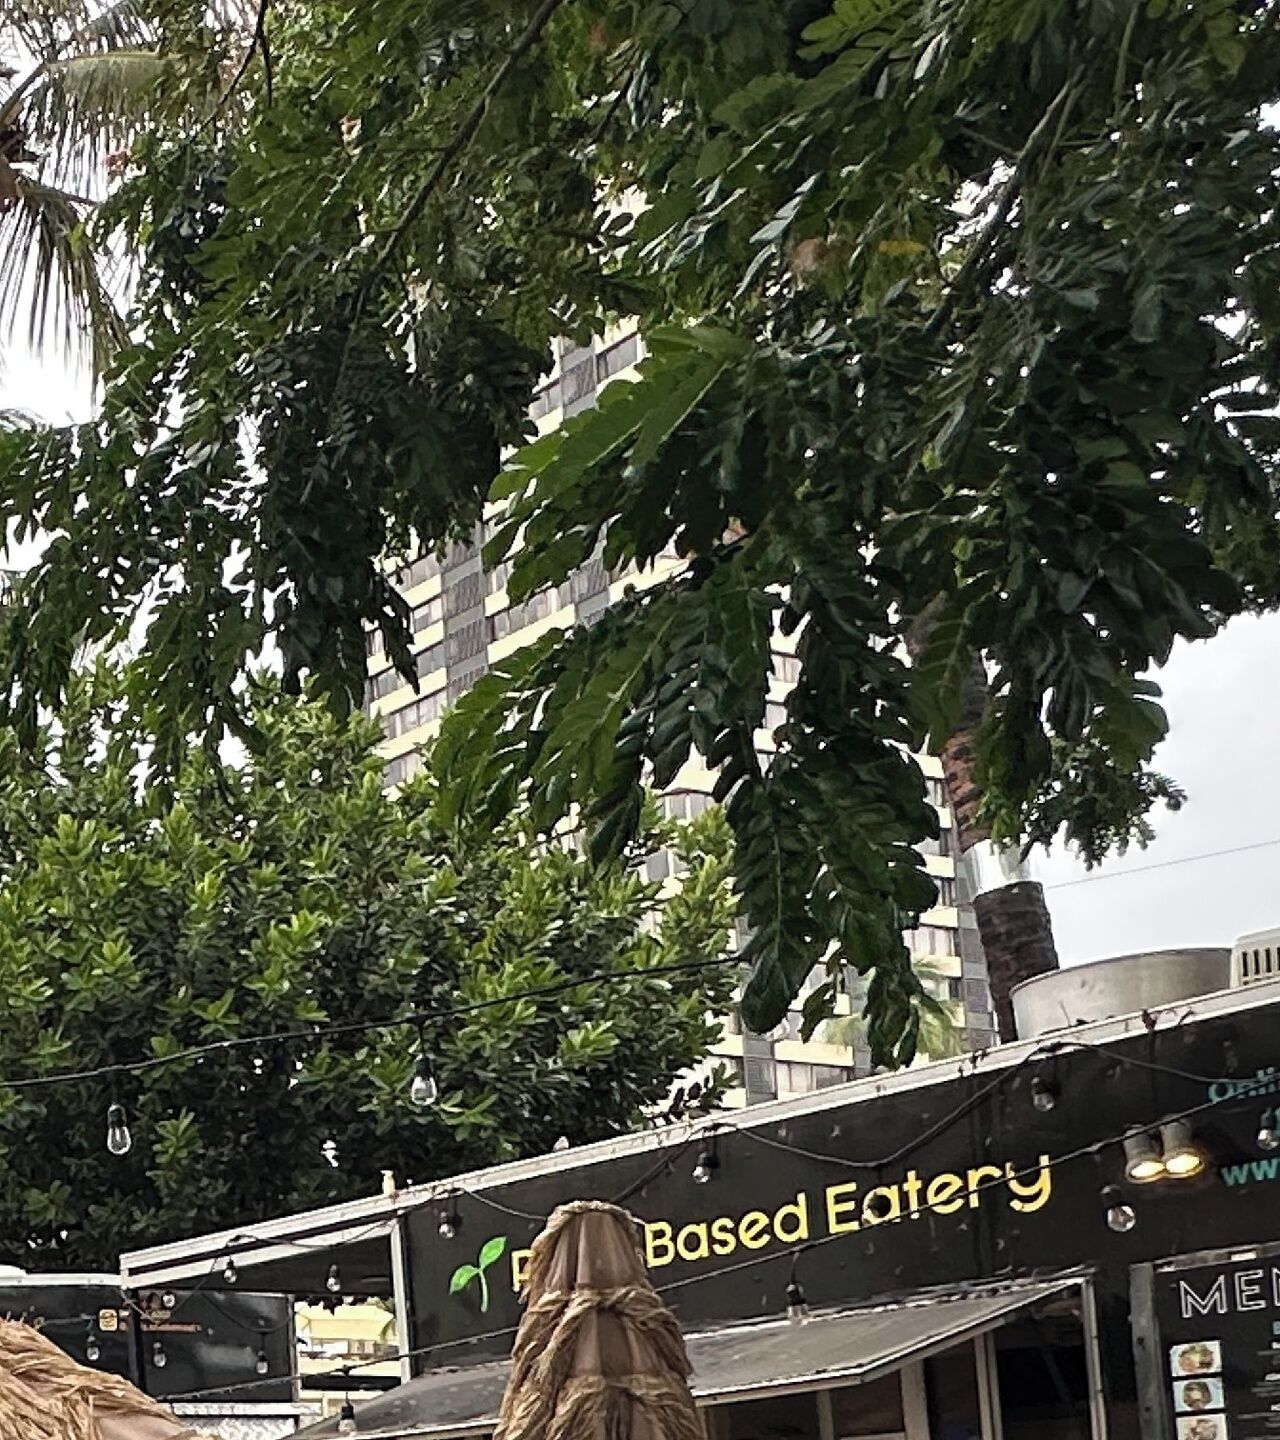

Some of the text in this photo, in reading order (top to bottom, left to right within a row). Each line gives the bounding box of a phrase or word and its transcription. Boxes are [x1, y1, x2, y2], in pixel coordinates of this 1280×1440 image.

[1221, 1156, 1280, 1187] ww
[644, 1154, 1053, 1269] Based Eatery
[1179, 1267, 1280, 1319] ME
